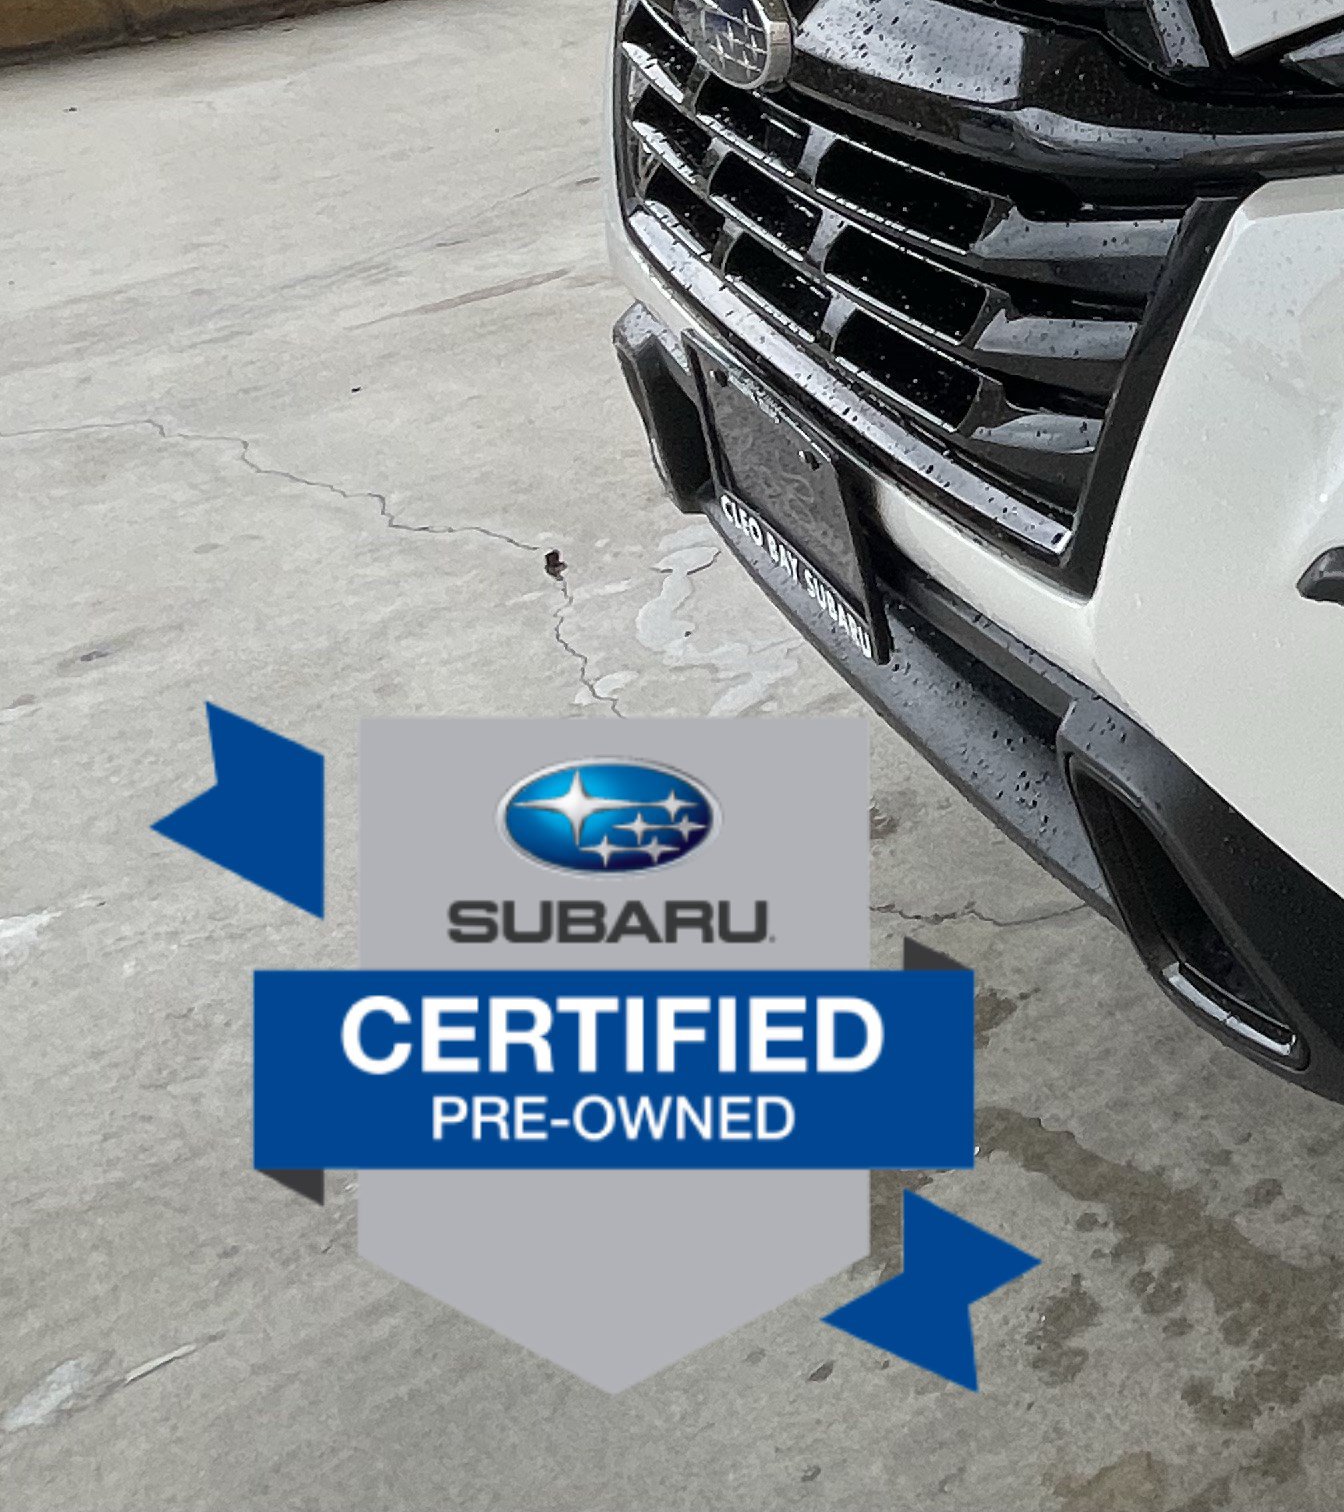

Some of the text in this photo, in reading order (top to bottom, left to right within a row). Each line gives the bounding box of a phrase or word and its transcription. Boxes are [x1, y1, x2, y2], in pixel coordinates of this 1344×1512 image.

[720, 494, 872, 659] CLEO BAY SUBARU
